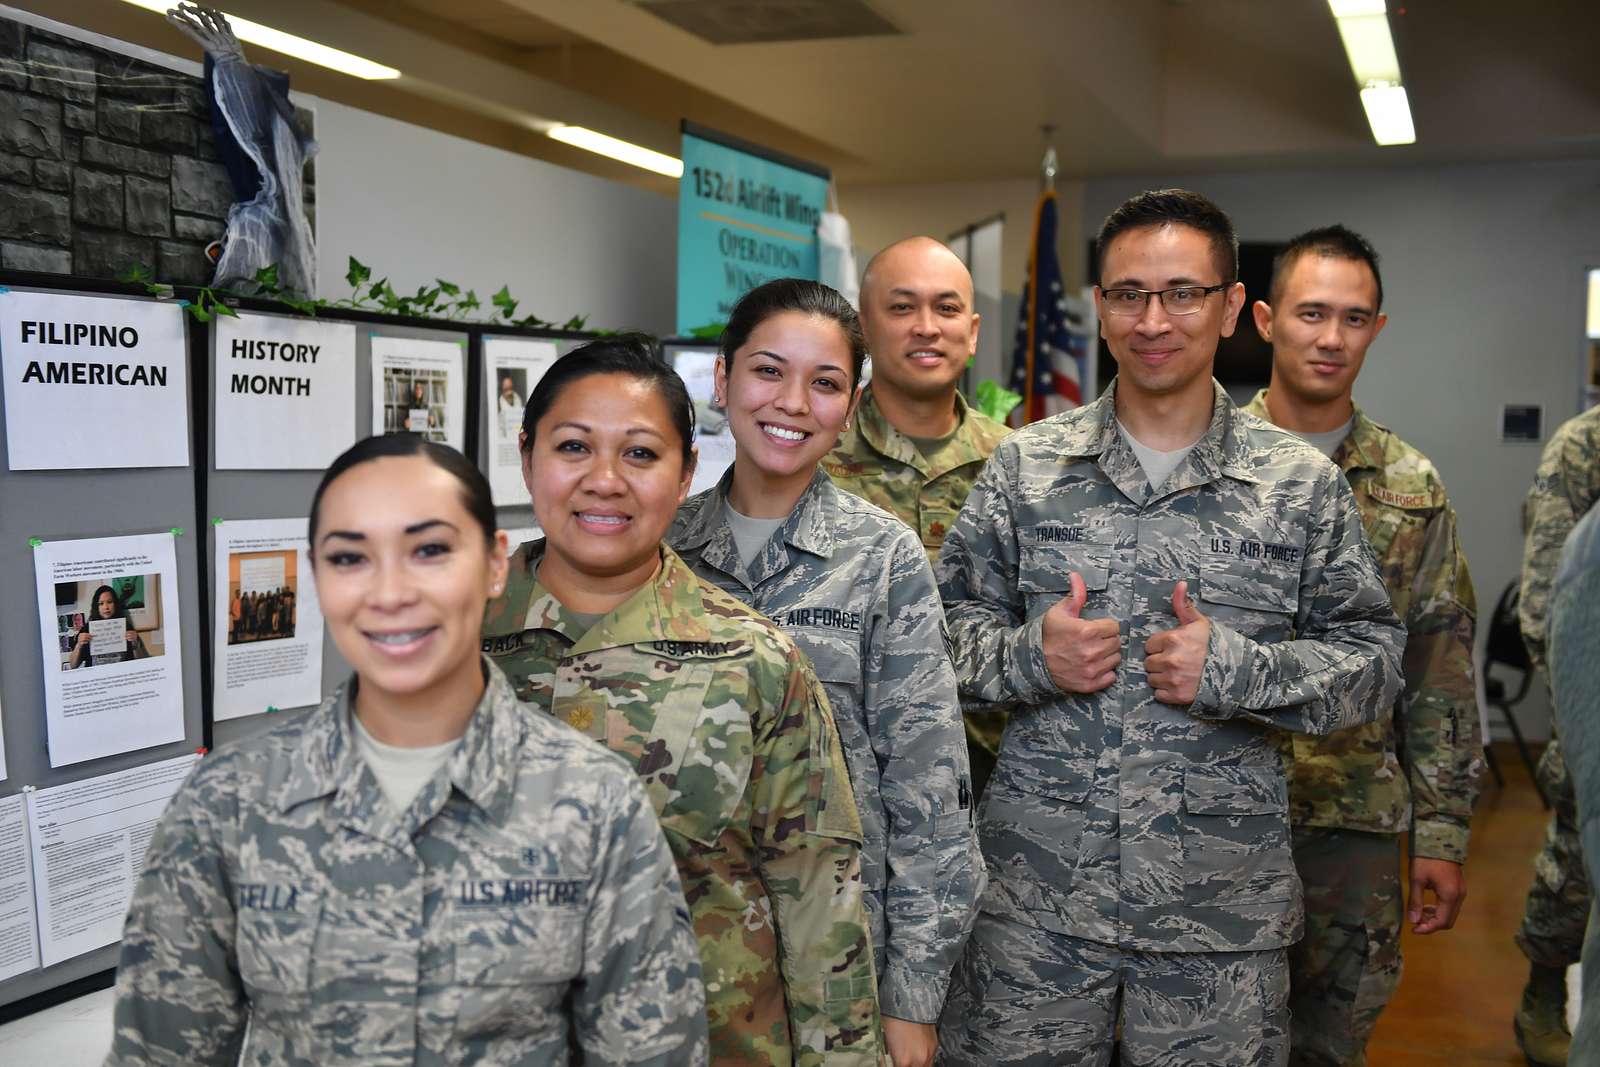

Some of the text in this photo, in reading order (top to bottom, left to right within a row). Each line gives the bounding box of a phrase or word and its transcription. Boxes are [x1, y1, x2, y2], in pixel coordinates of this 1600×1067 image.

[737, 177, 781, 218] Airlift
[719, 228, 799, 269] OPERATION
[21, 320, 139, 349] FILIPINO
[231, 338, 321, 364] HISTORY
[22, 360, 168, 387] AMERICAN
[231, 373, 311, 397] MONTH
[1396, 493, 1426, 507] FORCE
[1211, 538, 1299, 563] U.S. AIR FORCE
[787, 607, 811, 626] AIR
[813, 606, 861, 631] FORCE
[653, 640, 729, 656] U.S. ARMY
[503, 878, 533, 906] AIR
